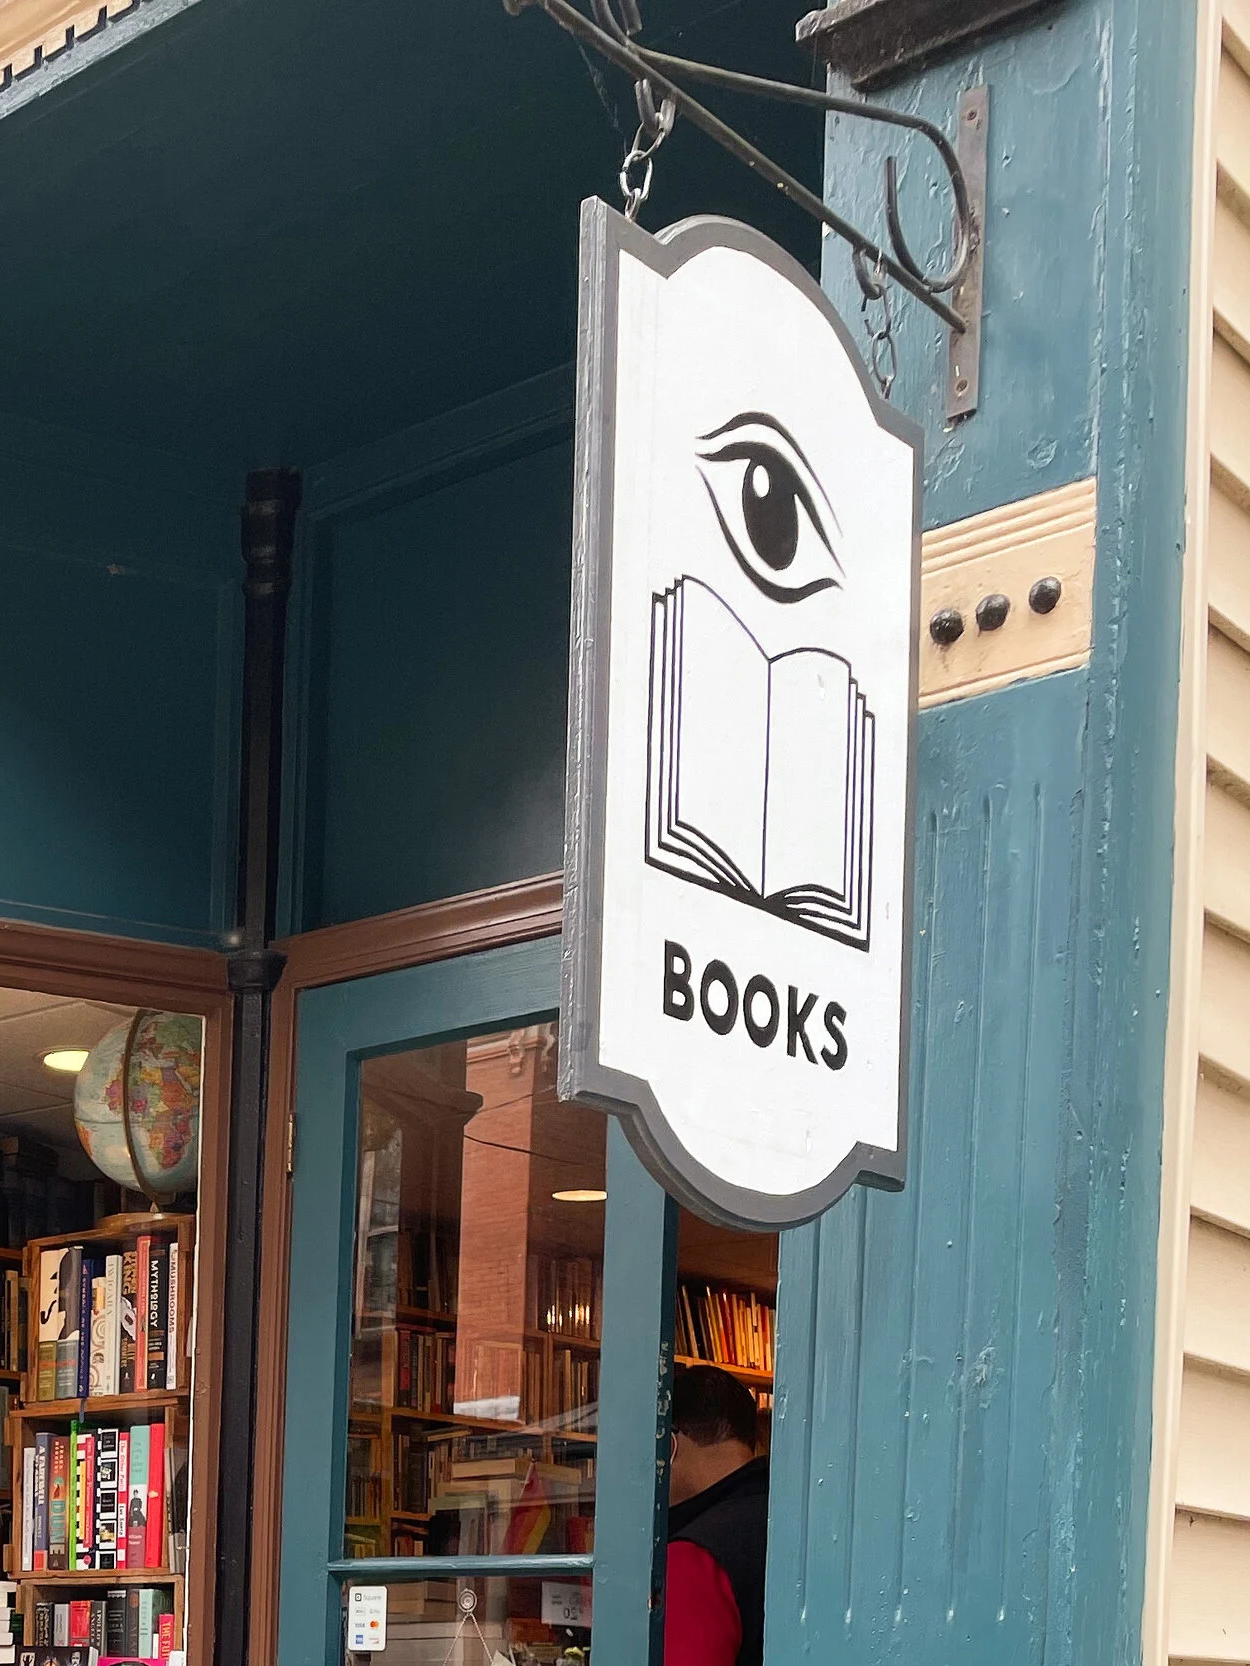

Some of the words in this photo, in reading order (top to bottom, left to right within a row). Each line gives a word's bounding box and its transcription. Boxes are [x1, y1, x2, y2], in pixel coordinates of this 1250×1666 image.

[662, 938, 849, 1072] BOOKS
[150, 1260, 159, 1328] MYTHOLOGY
[168, 1261, 178, 1334] MUSHROOMS
[50, 1501, 66, 1555] DUNE
[161, 1622, 172, 1640] THE
